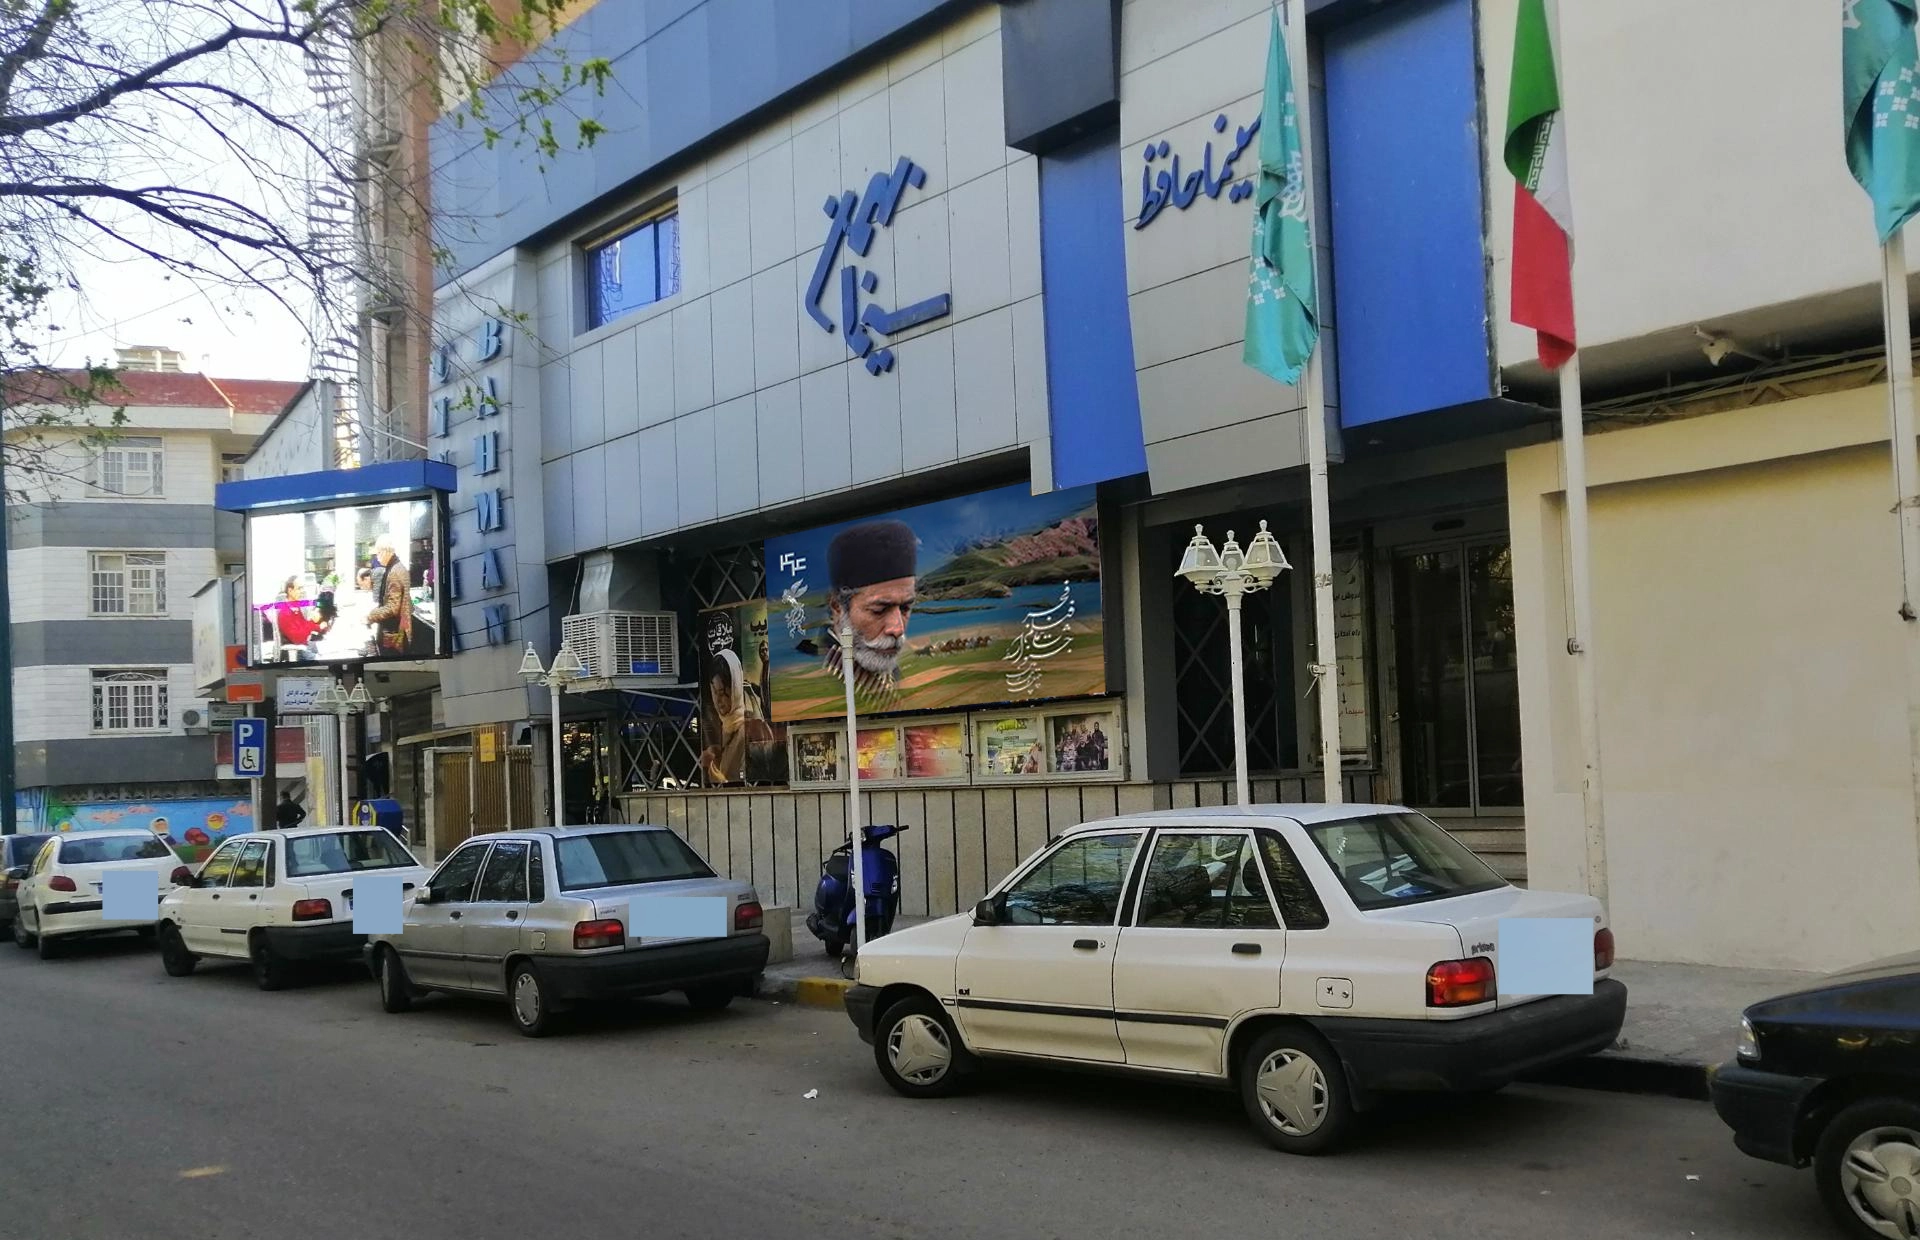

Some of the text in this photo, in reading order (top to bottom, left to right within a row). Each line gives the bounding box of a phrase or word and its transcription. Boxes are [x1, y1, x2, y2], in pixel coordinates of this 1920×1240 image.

[1133, 138, 1202, 232] حافظ
[804, 155, 927, 335] بهمن
[840, 264, 952, 377] سینما
[472, 318, 511, 648] BAHMAN
[707, 622, 734, 638] ملاقات
[707, 634, 735, 651] خصوصی
[239, 723, 254, 745] P
